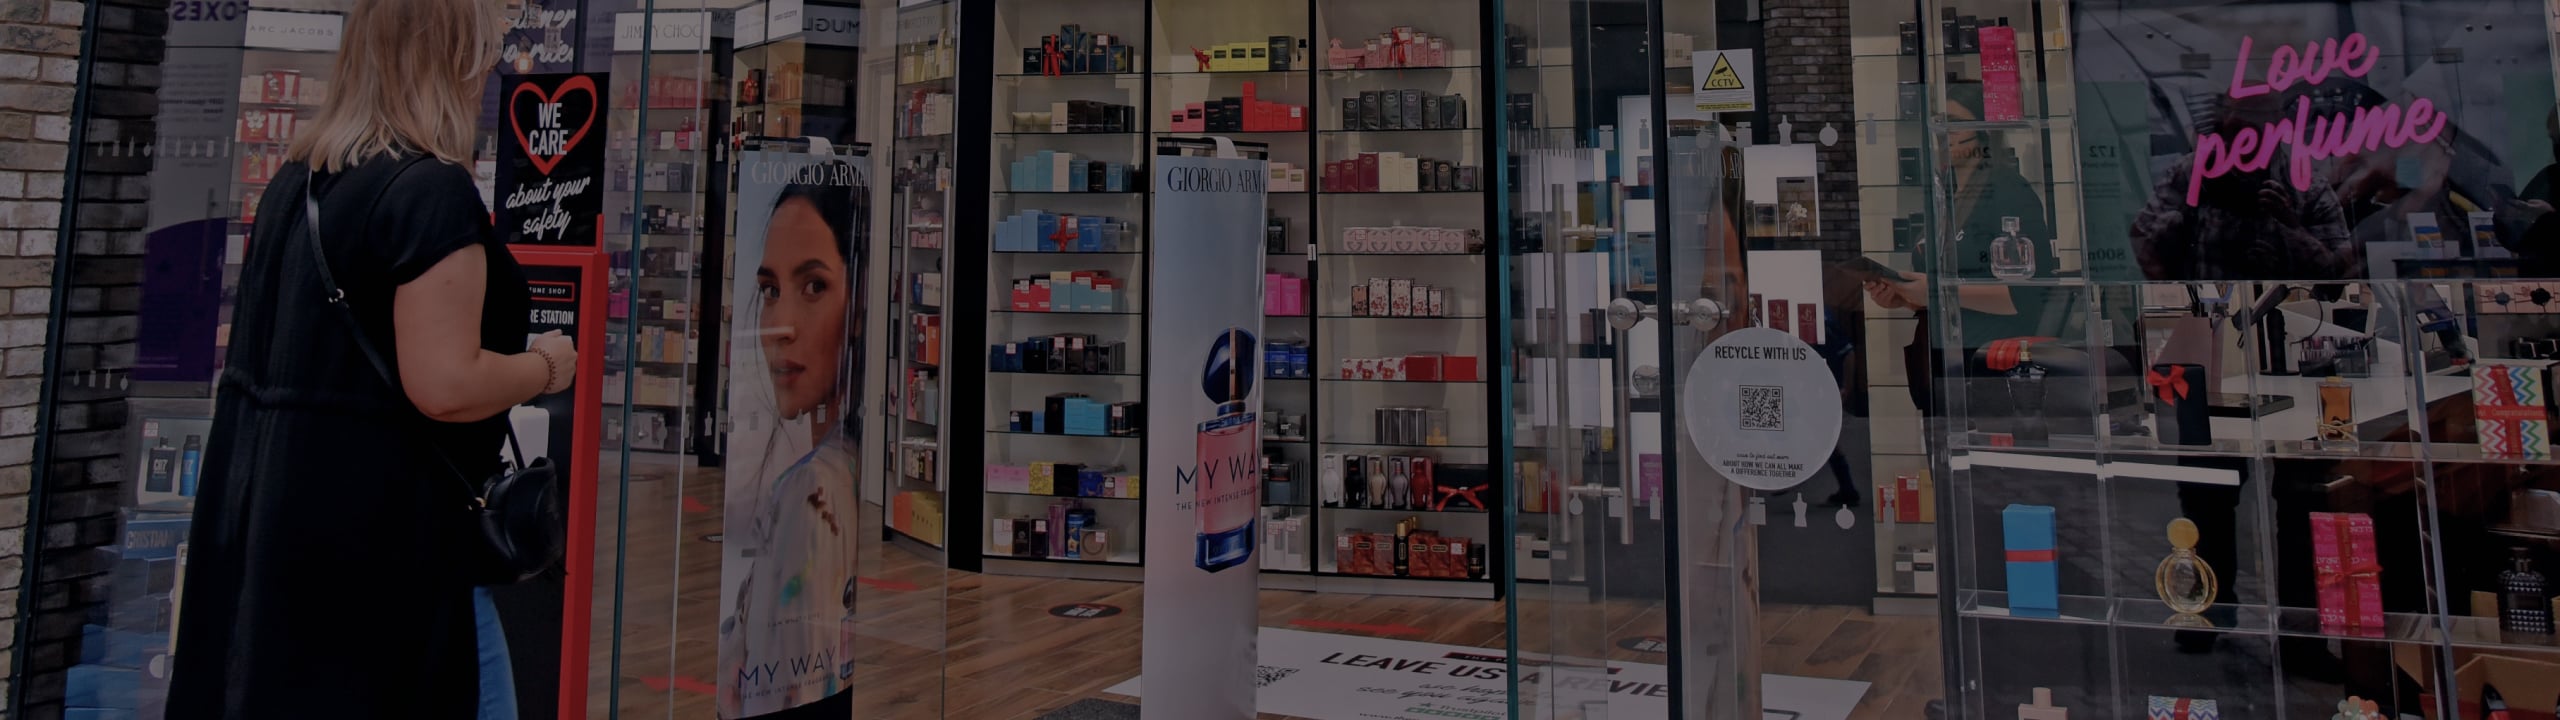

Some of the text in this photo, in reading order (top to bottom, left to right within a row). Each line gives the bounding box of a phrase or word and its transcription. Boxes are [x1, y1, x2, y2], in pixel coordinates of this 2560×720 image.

[249, 25, 335, 37] ARC JACOBS
[621, 24, 661, 39] JIMY
[2229, 32, 2380, 99] Love
[1711, 79, 1735, 88] CCTV
[538, 102, 563, 129] WE
[528, 129, 569, 156] CARE
[2186, 95, 2448, 208] perfume
[751, 161, 825, 186] GIORGIO
[1167, 166, 1232, 193] GIORGIO
[506, 176, 591, 214] about your
[522, 207, 572, 241] safety
[548, 287, 566, 295] SHOP
[530, 309, 575, 325] RE STATION
[1715, 346, 1807, 361] RECYCLE WITH US
[1176, 459, 1219, 494] MY
[1722, 460, 1740, 468] ABOUT
[1755, 461, 1764, 469] WE
[1765, 462, 1776, 470] CAN
[1788, 463, 1804, 471] MAKE
[1735, 468, 1768, 477] DIFFERENCE
[1769, 470, 1797, 478] TOGETHER
[1176, 491, 1239, 511] THE NEW INTENSE
[738, 660, 780, 689] MY
[790, 645, 836, 678] WAY
[1320, 652, 1447, 675] LEAVE
[1447, 664, 1507, 680] US
